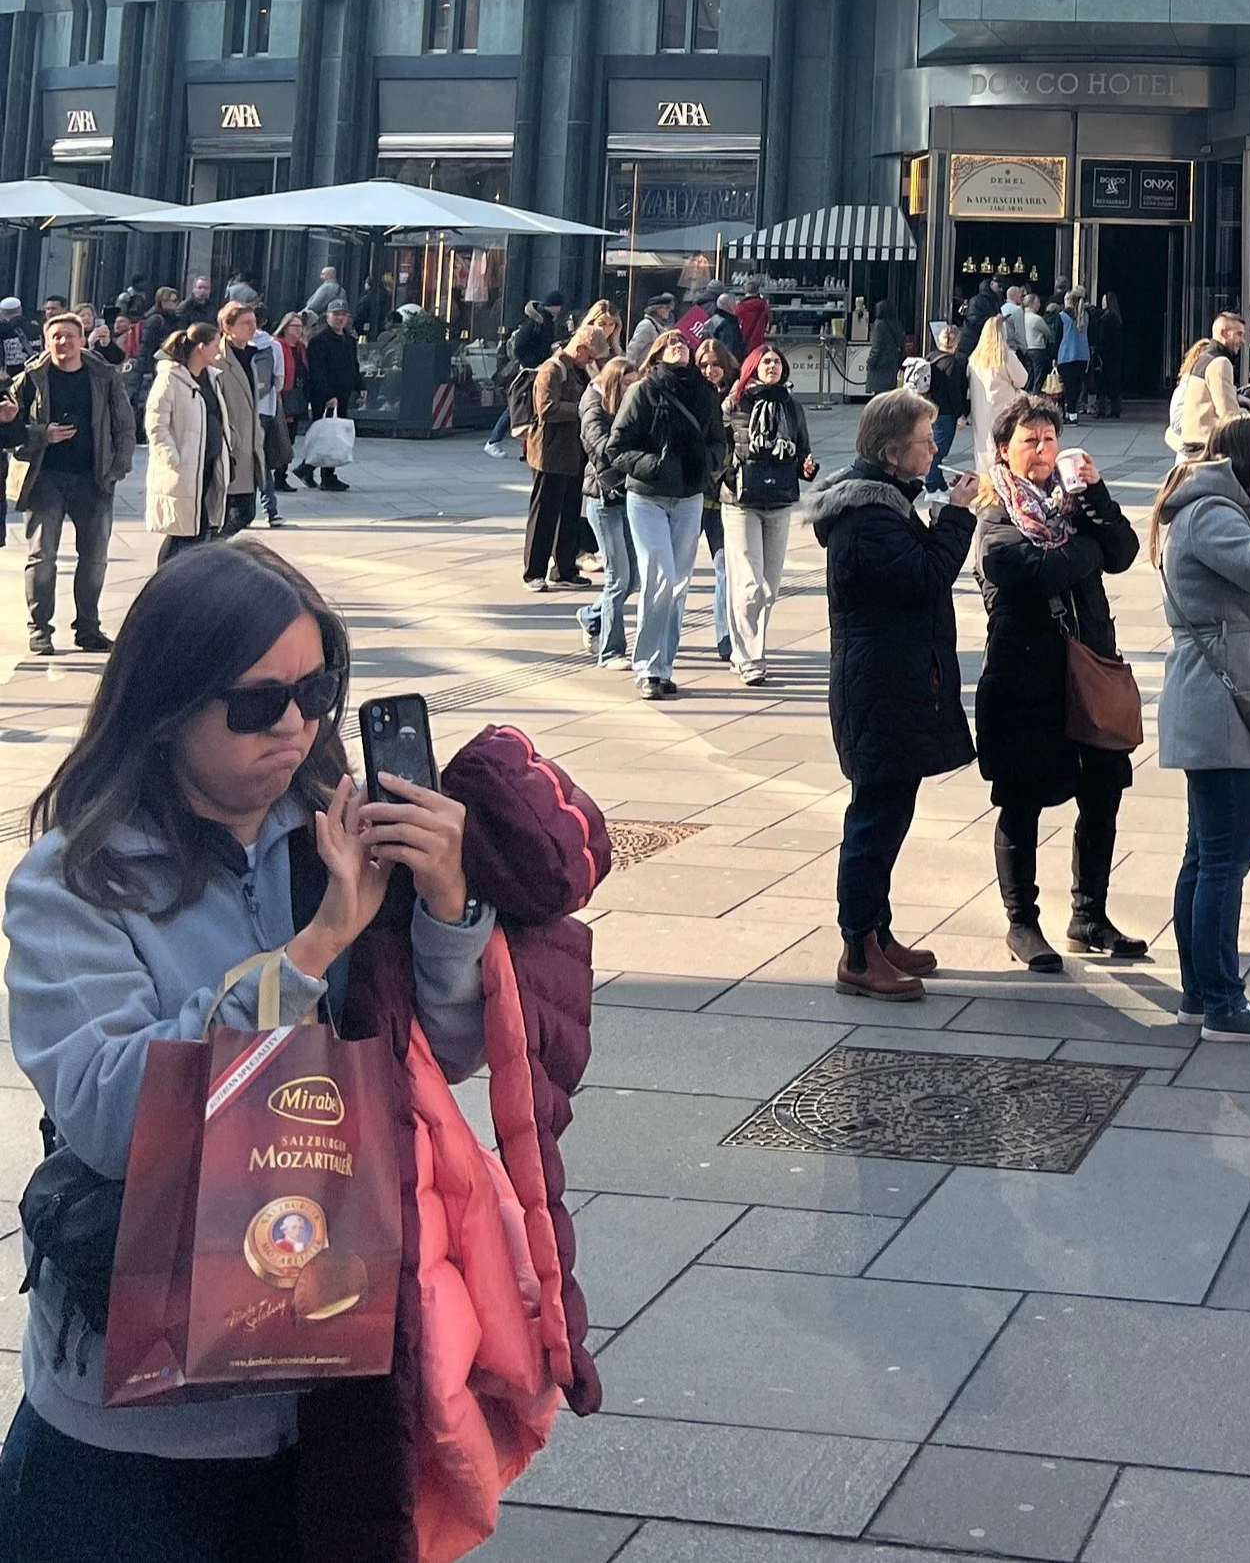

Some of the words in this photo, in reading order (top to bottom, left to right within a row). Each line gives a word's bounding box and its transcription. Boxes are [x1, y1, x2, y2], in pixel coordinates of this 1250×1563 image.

[970, 73, 1008, 96] DO
[1014, 74, 1029, 95] &
[1036, 73, 1079, 95] CO
[1087, 73, 1182, 97] HOTEL
[67, 110, 97, 133] ZARA
[221, 104, 262, 128] ZARA
[657, 102, 711, 127] ZARA
[990, 177, 1025, 185] DEMEL
[1143, 179, 1175, 192] ONYX
[966, 196, 1047, 205] KAISERSCHMARRN
[281, 1135, 346, 1152] SALZBURGER
[249, 1144, 353, 1177] MOZARTTALER
